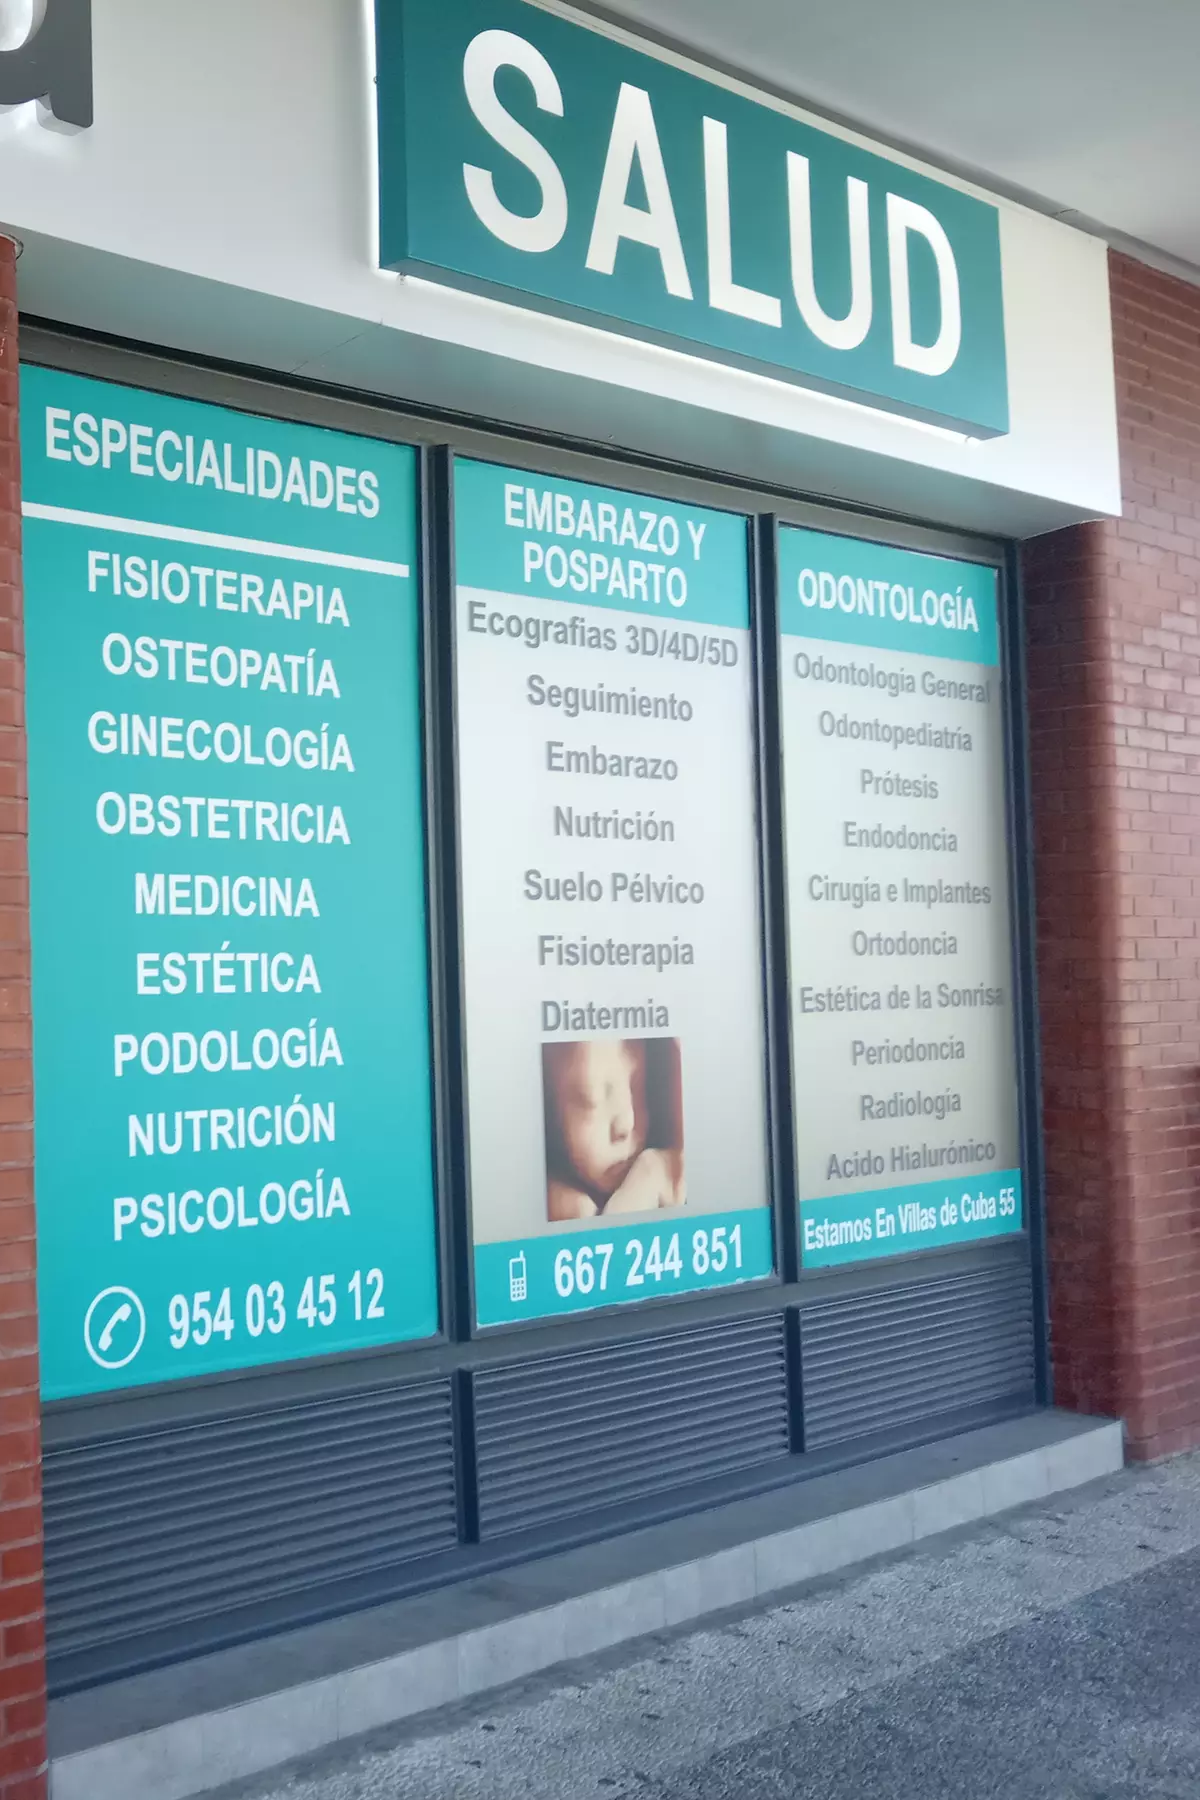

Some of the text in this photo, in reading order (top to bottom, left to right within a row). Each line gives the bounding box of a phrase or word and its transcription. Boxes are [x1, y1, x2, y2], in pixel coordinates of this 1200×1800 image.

[463, 29, 962, 377] SALUD
[45, 406, 380, 519] ESPECIALIDADES
[504, 483, 707, 560] EMBARAZO Y
[87, 550, 350, 627] FISIOTERAPIA
[523, 540, 688, 608] POSPARTO
[798, 568, 979, 632] ODONTOLOGÍA
[102, 632, 341, 699] OSTEOPATÍA
[625, 625, 738, 667] 3D/4D/5D
[527, 674, 693, 722] Seguimiento
[921, 670, 990, 703] General
[88, 710, 355, 772] GINECOLOGÍA
[819, 710, 972, 751] Odontopediatría
[546, 740, 678, 781] Embarazo
[860, 768, 939, 799] Prótesis
[96, 791, 352, 845] OBSTETRICIA
[553, 806, 675, 842] Nutrición
[843, 821, 958, 852] Endodoncia
[135, 872, 321, 918] MEDICINA
[524, 869, 705, 904] Suelo Pélvico
[808, 874, 992, 909] Cirugía e Implantes
[136, 941, 322, 995] ESTÉTICA
[538, 935, 694, 972] Fisioterapia
[852, 930, 958, 956] Ortodoncia
[541, 998, 669, 1031] Diatermia
[800, 982, 1006, 1013] Estética de la Sonrisa
[114, 1018, 344, 1077] PODOLOGÍA
[128, 1094, 336, 1157] NUTRICIÓN
[891, 1138, 996, 1172] Hialurónico
[113, 1169, 351, 1241] PSICOLOGÍA
[803, 1187, 1016, 1251] Estamos En Villas de Cuba 55
[554, 1224, 743, 1297] 667 244 851
[168, 1267, 385, 1350] 954 03 45 12
